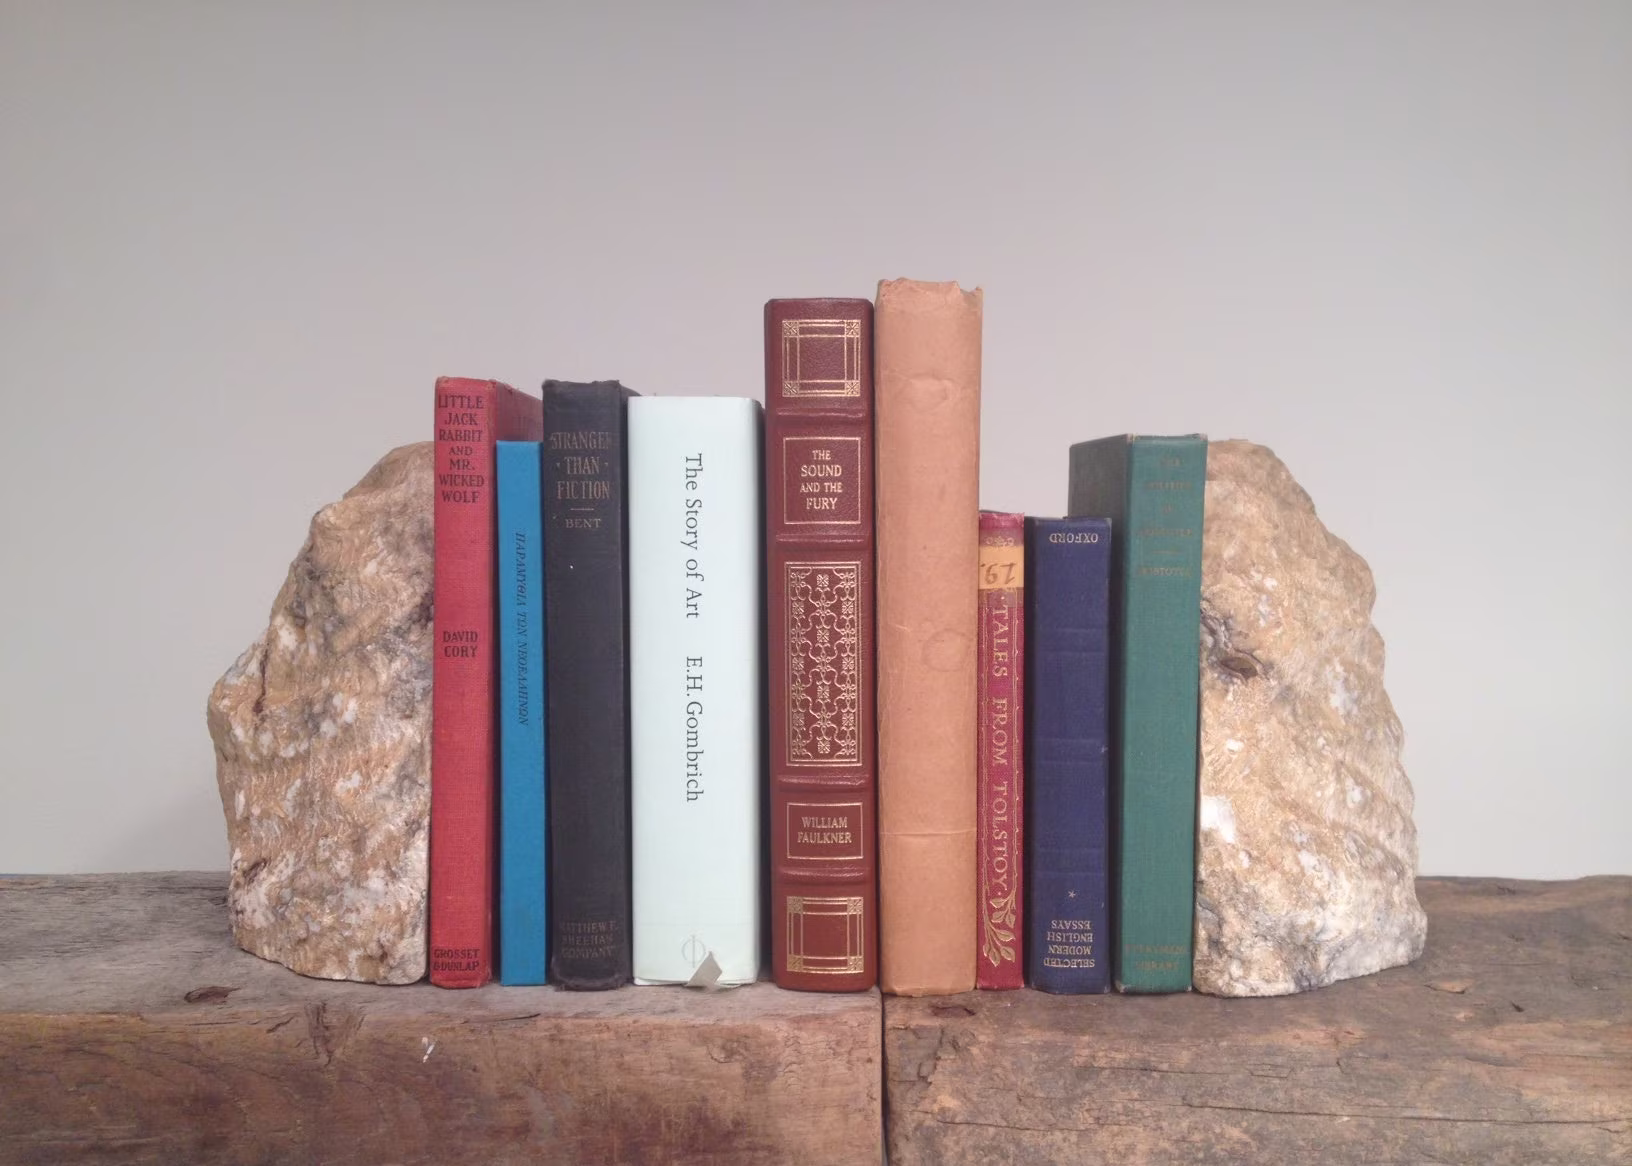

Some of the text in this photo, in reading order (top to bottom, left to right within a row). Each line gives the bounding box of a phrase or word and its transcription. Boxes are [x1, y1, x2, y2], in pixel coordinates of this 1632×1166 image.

[438, 395, 484, 409] LITTLE
[445, 412, 478, 426] JACK
[439, 429, 483, 442] RABBIT
[448, 446, 473, 456] AND
[812, 450, 831, 460] THE
[449, 458, 475, 471] MR.
[564, 456, 601, 475] THAN
[801, 464, 842, 477] SOUND
[439, 474, 485, 487] WICKED
[557, 480, 610, 499] FICTION
[800, 482, 843, 493] AND THE
[441, 490, 481, 504] WOLF
[806, 497, 838, 510] FURY
[565, 518, 601, 529] BENT
[680, 453, 705, 618] The Story of Art
[1049, 532, 1099, 544] OXFORD
[443, 630, 479, 643] DAVID
[992, 604, 1009, 677] TALES
[444, 645, 478, 658] CORY
[992, 698, 1009, 765] FROM
[801, 816, 848, 828] WILLIAM
[797, 831, 852, 844] FAULKNER
[1051, 919, 1091, 930] ESSAYS
[1046, 931, 1093, 943] ENGLISH
[433, 948, 480, 960] GROSSET
[1048, 944, 1092, 955] MODERN
[1043, 957, 1095, 968] SELECTED
